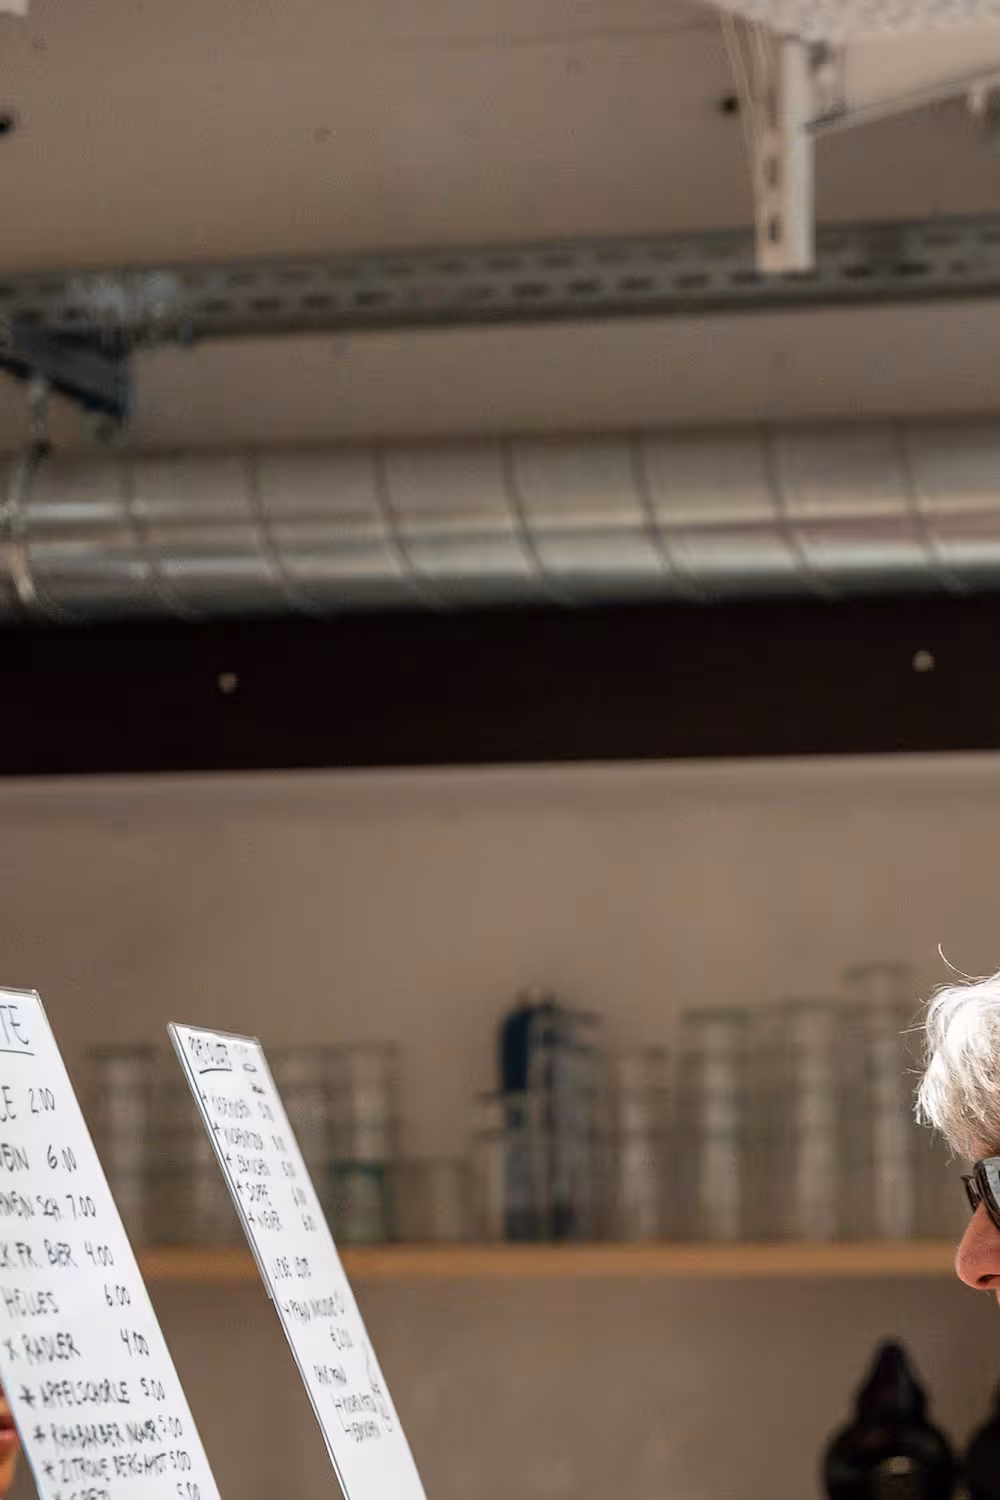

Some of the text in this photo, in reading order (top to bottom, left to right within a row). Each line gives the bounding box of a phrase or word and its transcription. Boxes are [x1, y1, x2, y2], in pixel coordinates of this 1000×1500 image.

[28, 1087, 55, 1113] 2.00
[0, 1143, 77, 1172] EIN 6.00
[66, 1194, 96, 1220] 7.00
[84, 1240, 114, 1266] 4.00
[2, 1284, 131, 1318] HELLES 6.00
[22, 1328, 149, 1365] RADLER 4.00
[40, 1377, 165, 1408] APFELSCHORLE 5.00
[50, 1423, 124, 1449] RHABARBER
[159, 1415, 183, 1438] 5.00
[59, 1456, 112, 1484] ZITRONE
[170, 1450, 192, 1471] 5.00
